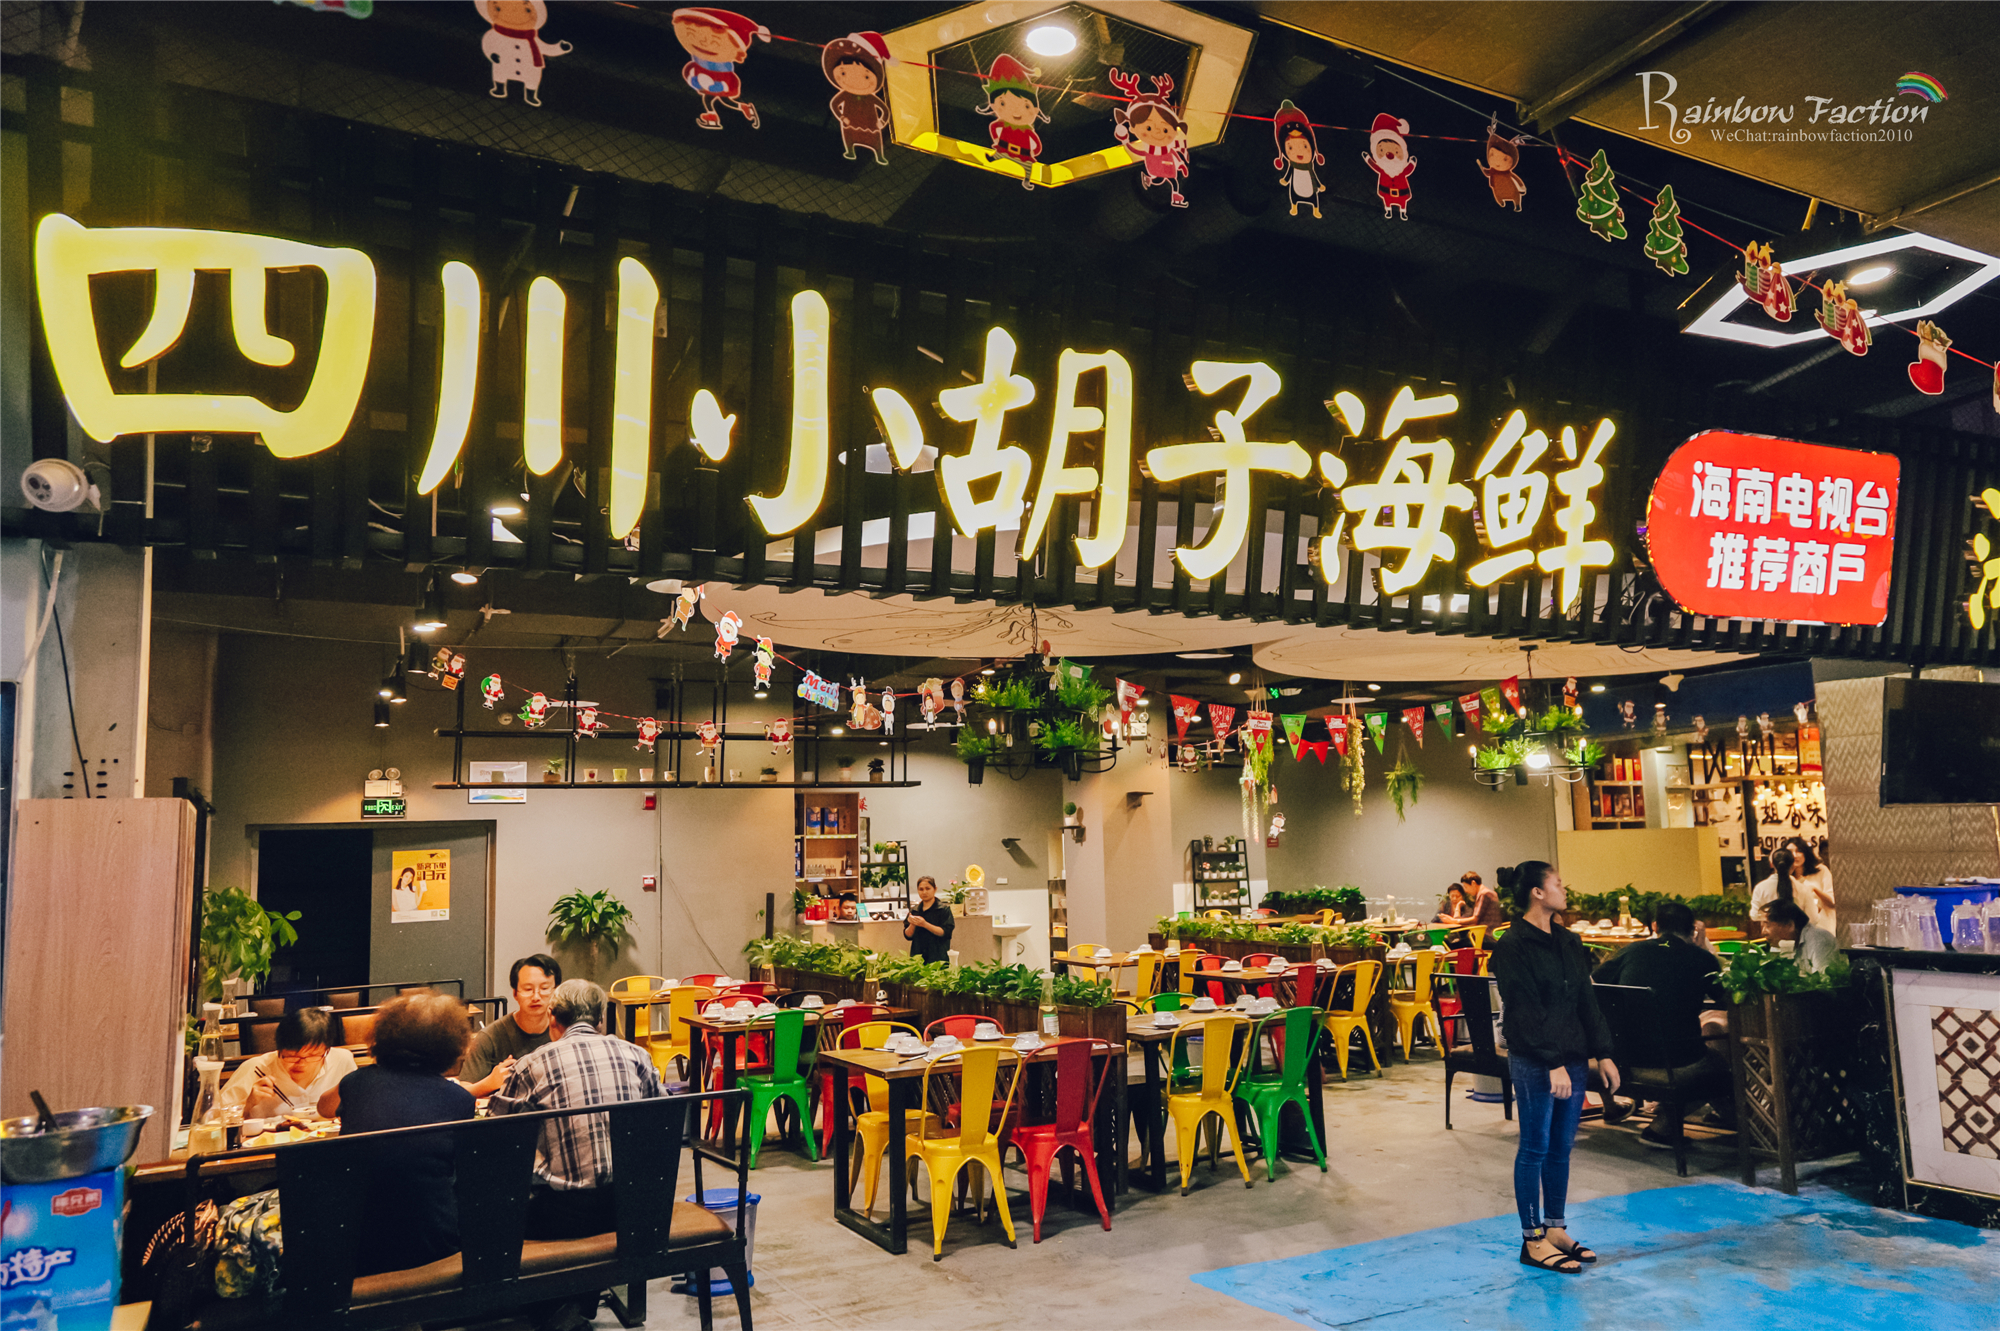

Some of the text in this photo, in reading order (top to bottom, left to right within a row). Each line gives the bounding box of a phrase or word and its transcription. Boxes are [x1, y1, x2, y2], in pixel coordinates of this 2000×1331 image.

[34, 211, 1617, 617] 四川小胡子海鲜
[1689, 460, 1890, 537] 海南电视台
[1706, 531, 1867, 596] 推荐商户
[804, 674, 839, 699] Merry
